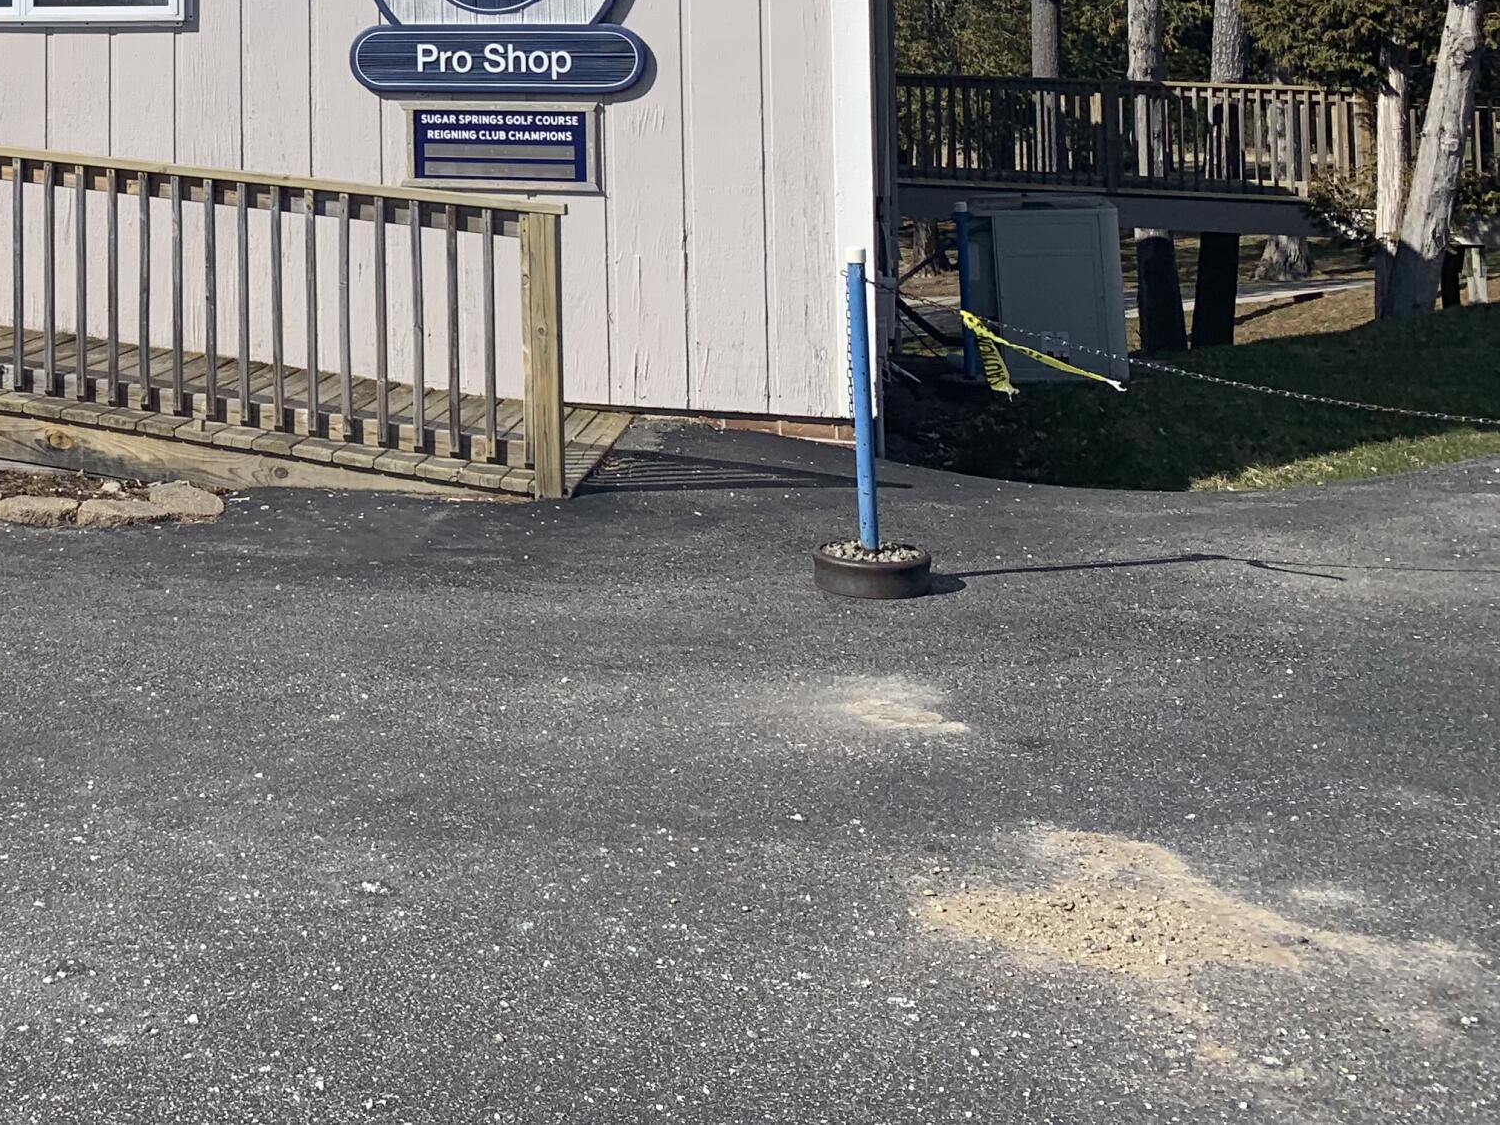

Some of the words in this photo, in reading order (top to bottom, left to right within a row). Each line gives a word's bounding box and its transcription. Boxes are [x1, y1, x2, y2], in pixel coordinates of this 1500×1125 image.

[416, 44, 472, 73] Pro
[483, 43, 572, 80] Shop
[421, 114, 457, 124] SUGAR
[458, 115, 503, 125] SPRINGS
[505, 115, 533, 125] GOLF
[535, 116, 579, 126] COURSE
[427, 130, 477, 140] REIGNING
[479, 131, 506, 140] CLUB
[508, 131, 573, 141] CHAMPIONS
